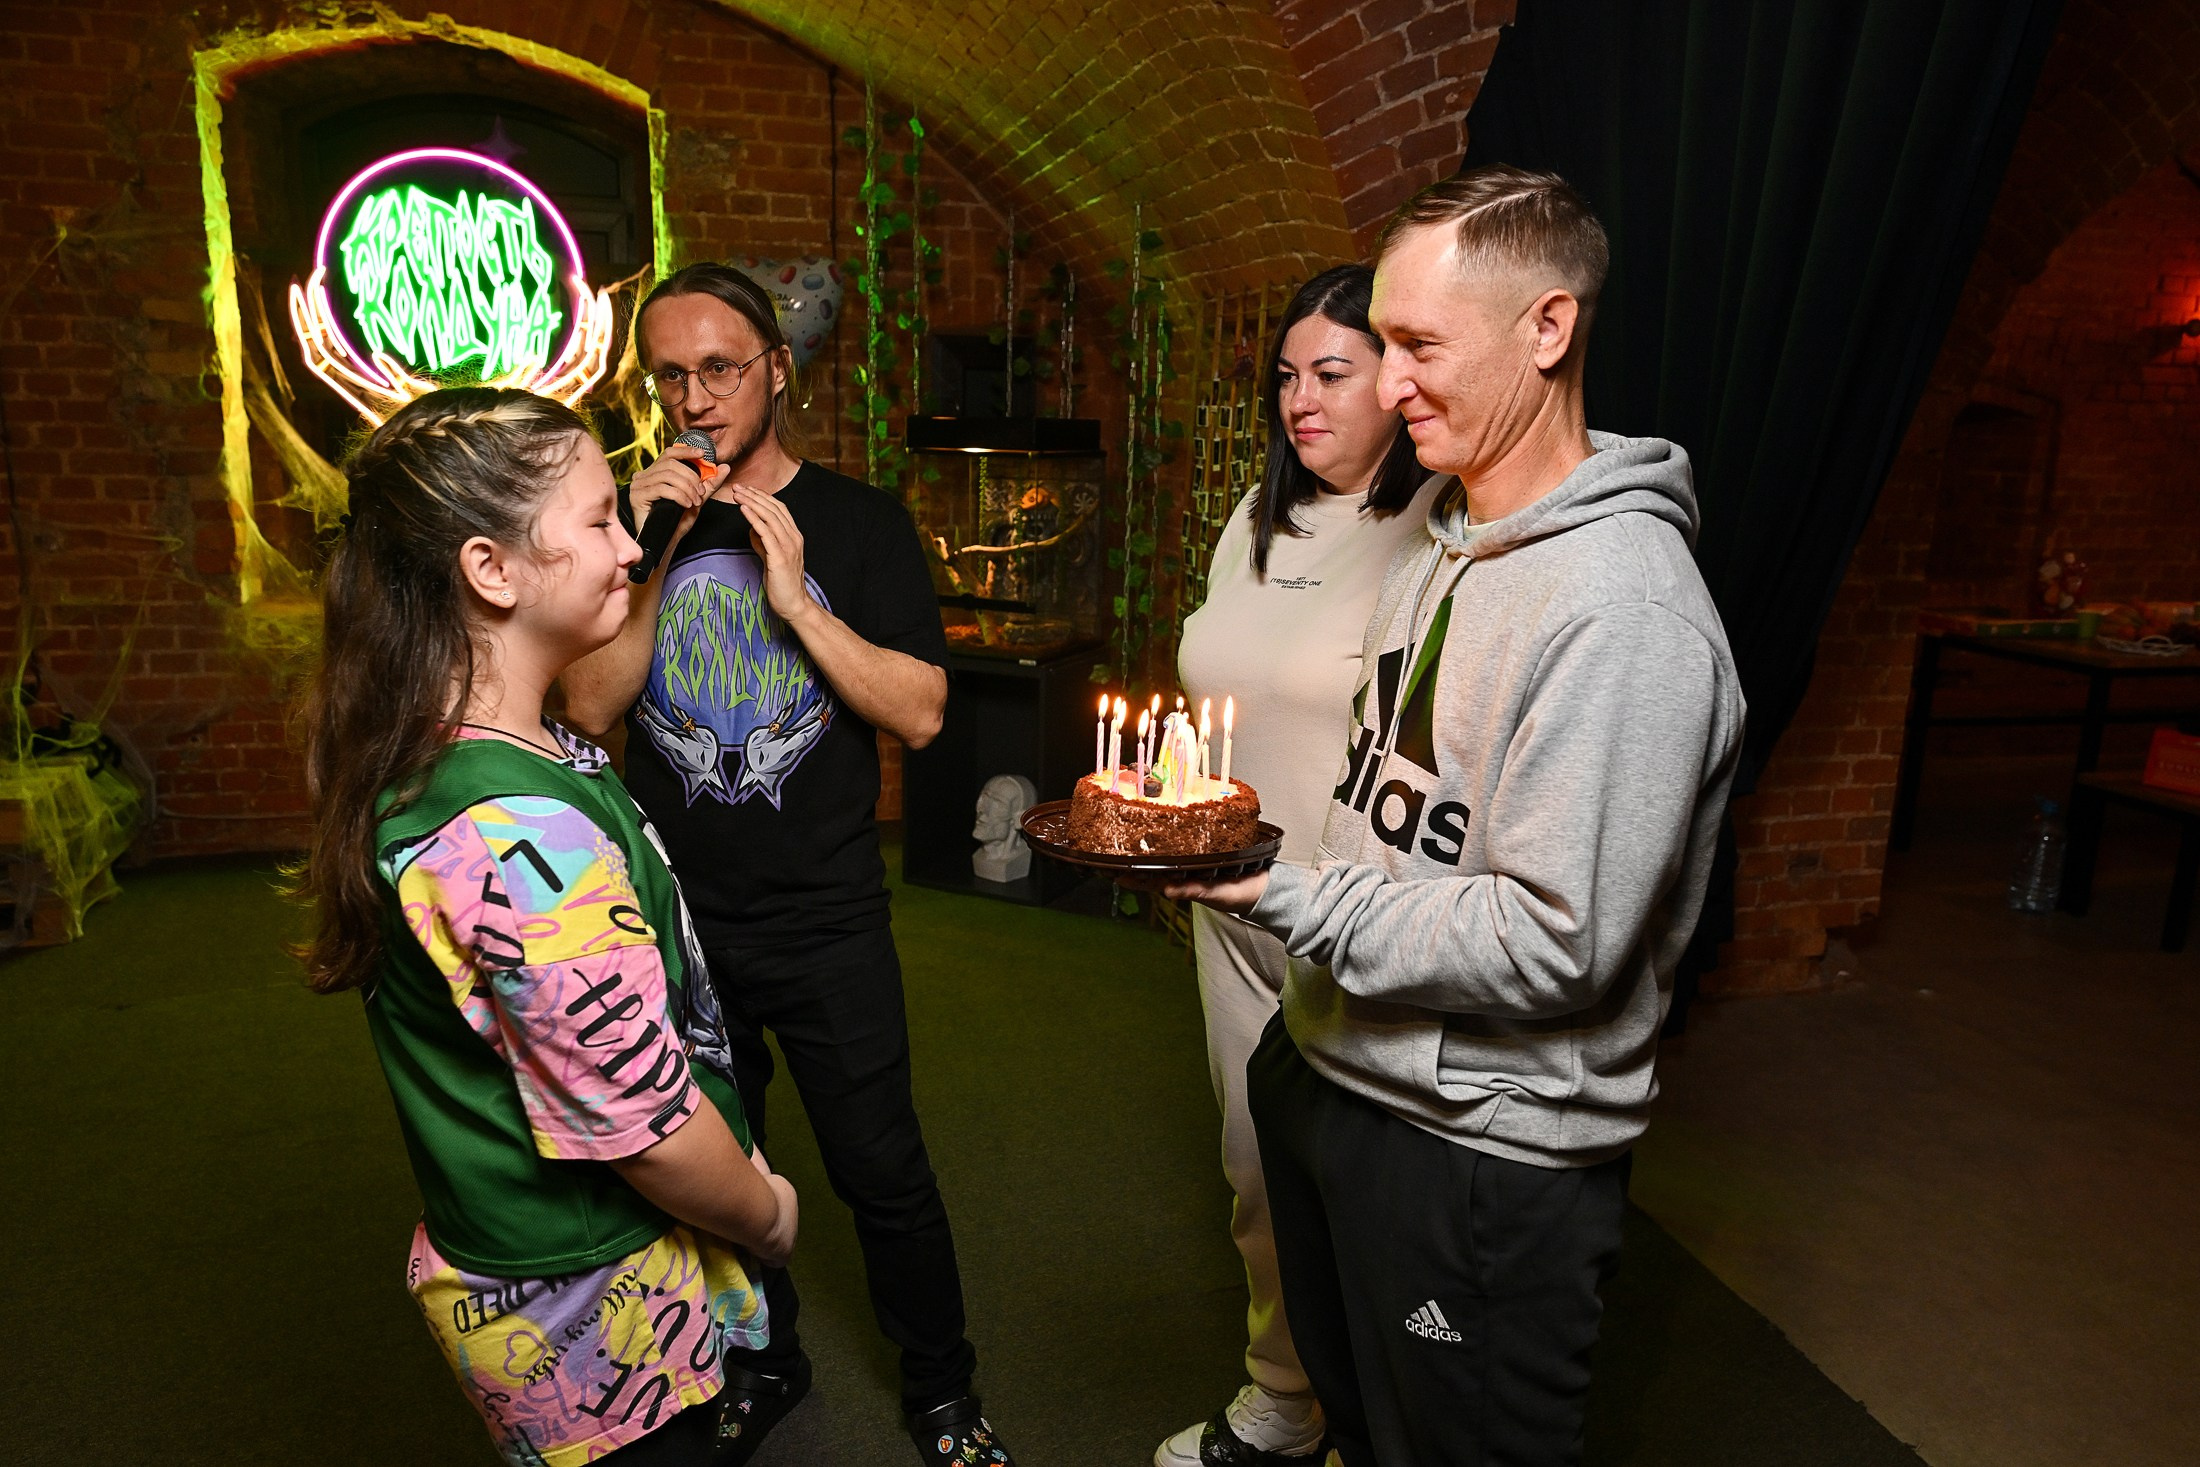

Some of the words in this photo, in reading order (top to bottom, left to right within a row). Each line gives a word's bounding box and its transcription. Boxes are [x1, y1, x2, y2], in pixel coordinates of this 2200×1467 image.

[662, 633, 810, 719] КОЛДУНА
[1406, 1319, 1462, 1342] adidas
[523, 1345, 569, 1387] vibe
